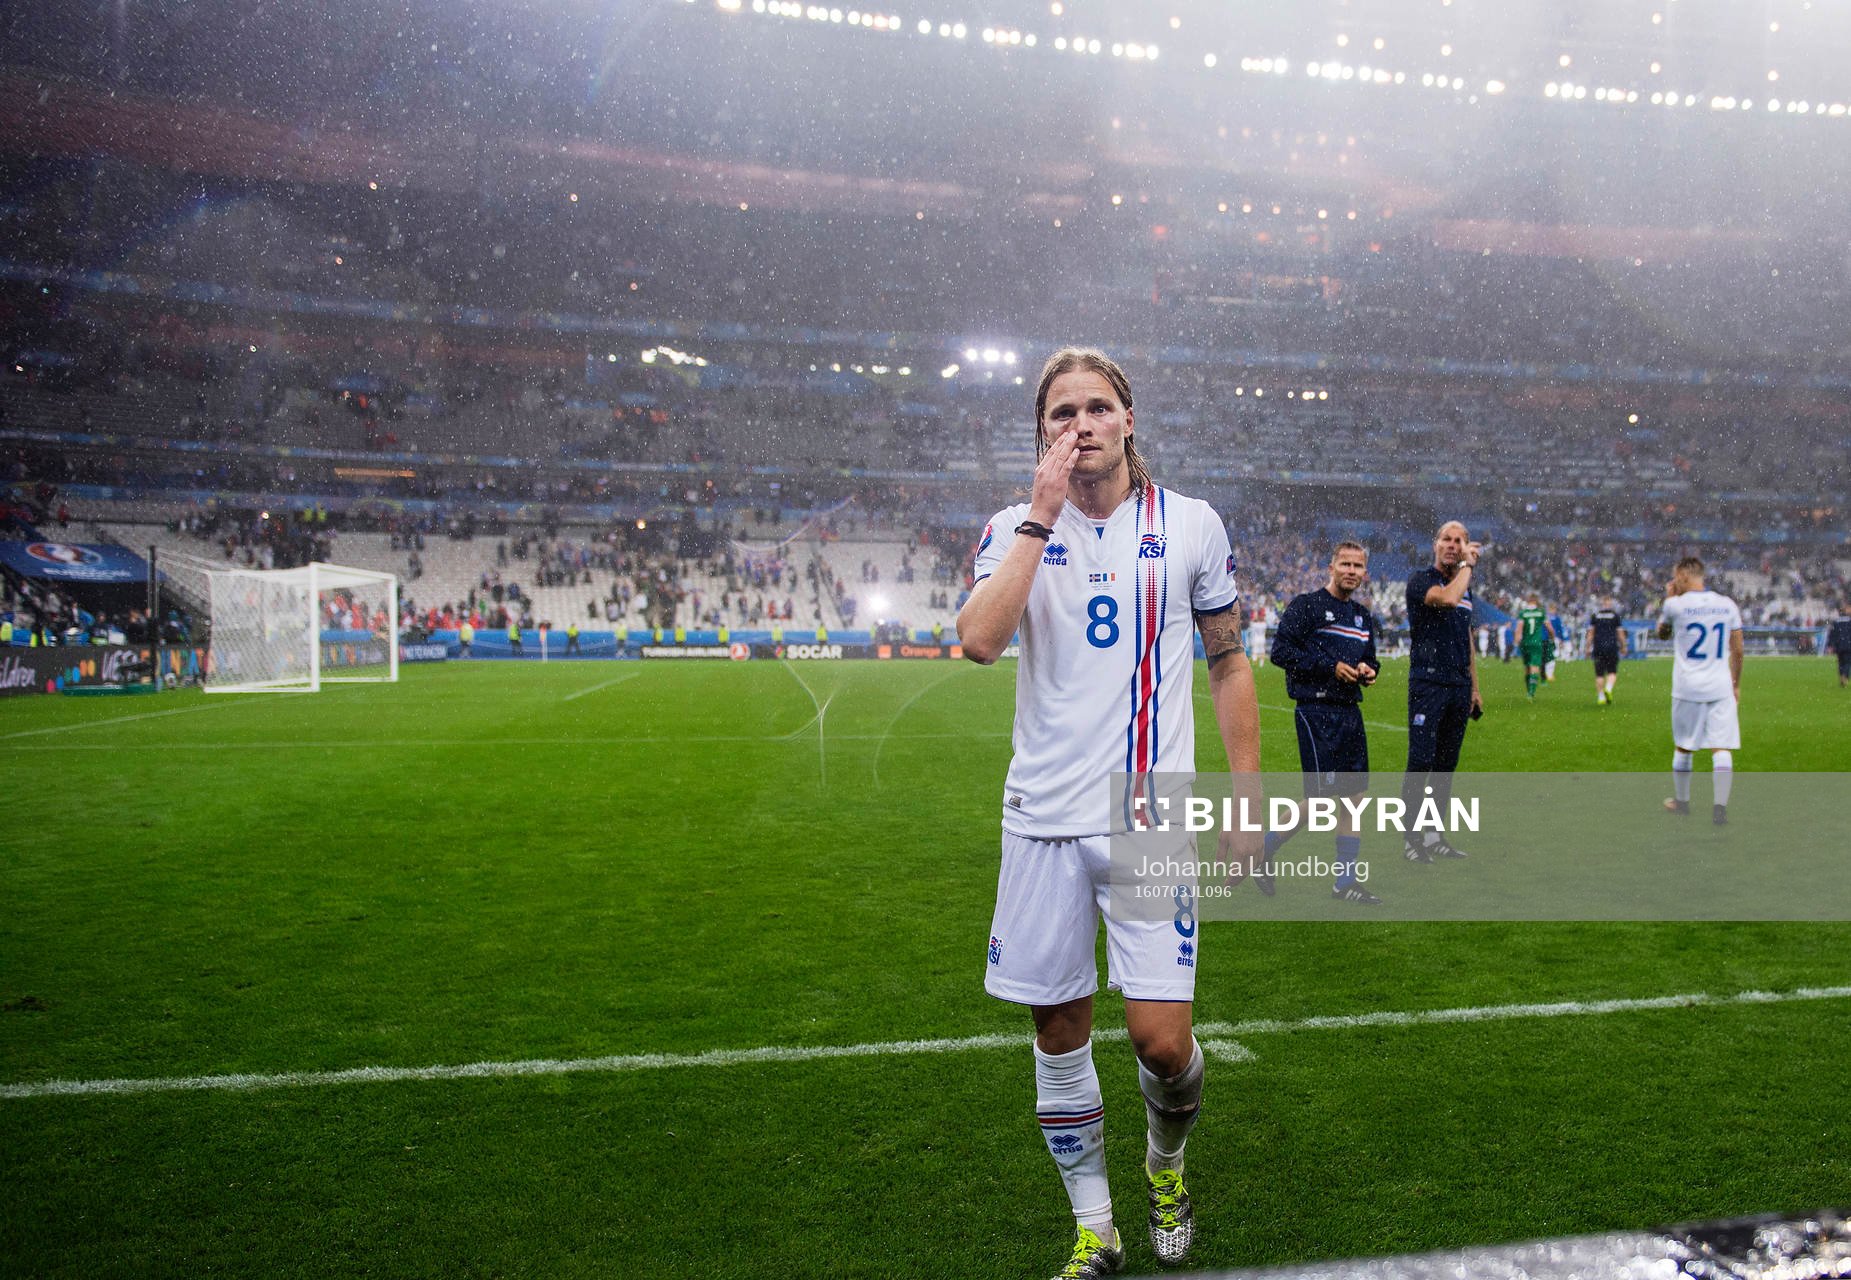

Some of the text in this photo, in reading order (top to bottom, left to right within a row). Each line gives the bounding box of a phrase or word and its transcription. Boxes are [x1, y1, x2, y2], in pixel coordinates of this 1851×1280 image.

[1086, 594, 1120, 649] 8
[787, 644, 843, 659] SOCAR
[900, 645, 941, 659] Orange
[1686, 622, 1725, 660] 21
[1173, 884, 1195, 939] 8
